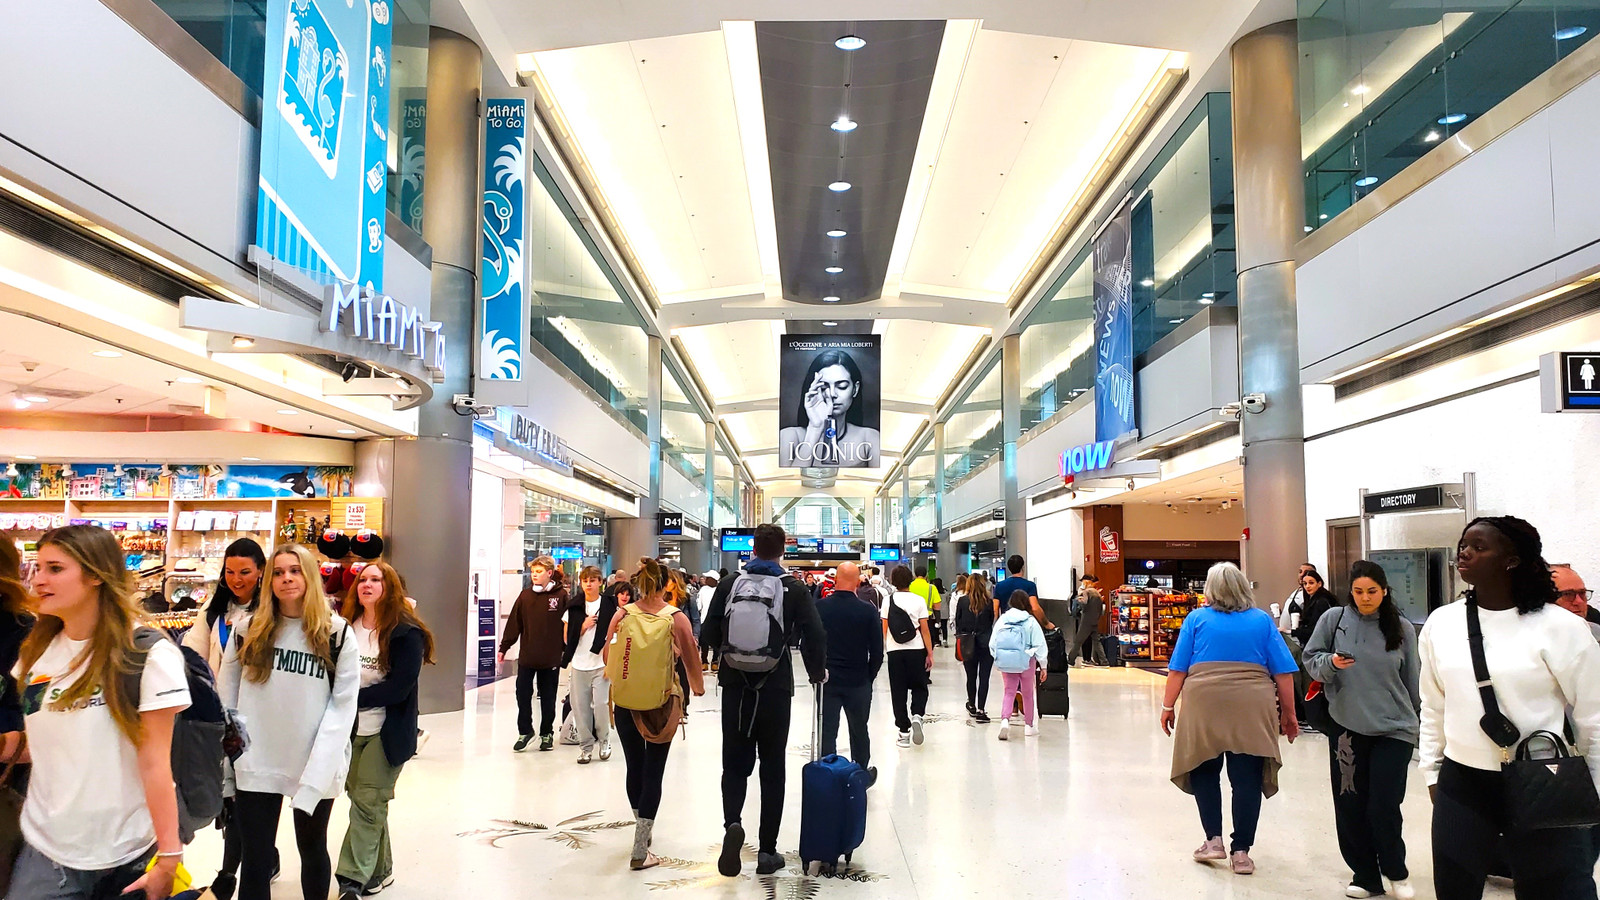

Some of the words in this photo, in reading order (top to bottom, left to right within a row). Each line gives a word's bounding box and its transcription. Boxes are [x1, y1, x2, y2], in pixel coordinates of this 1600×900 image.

[486, 106, 524, 118] MiAMi
[488, 118, 502, 129] TO
[515, 413, 541, 451] DUTY
[788, 441, 873, 461] ICONIC
[1381, 493, 1417, 508] DIRECTORY
[664, 518, 681, 526] D41
[271, 647, 325, 680] TMOUTH
[622, 637, 633, 680] patagonia
